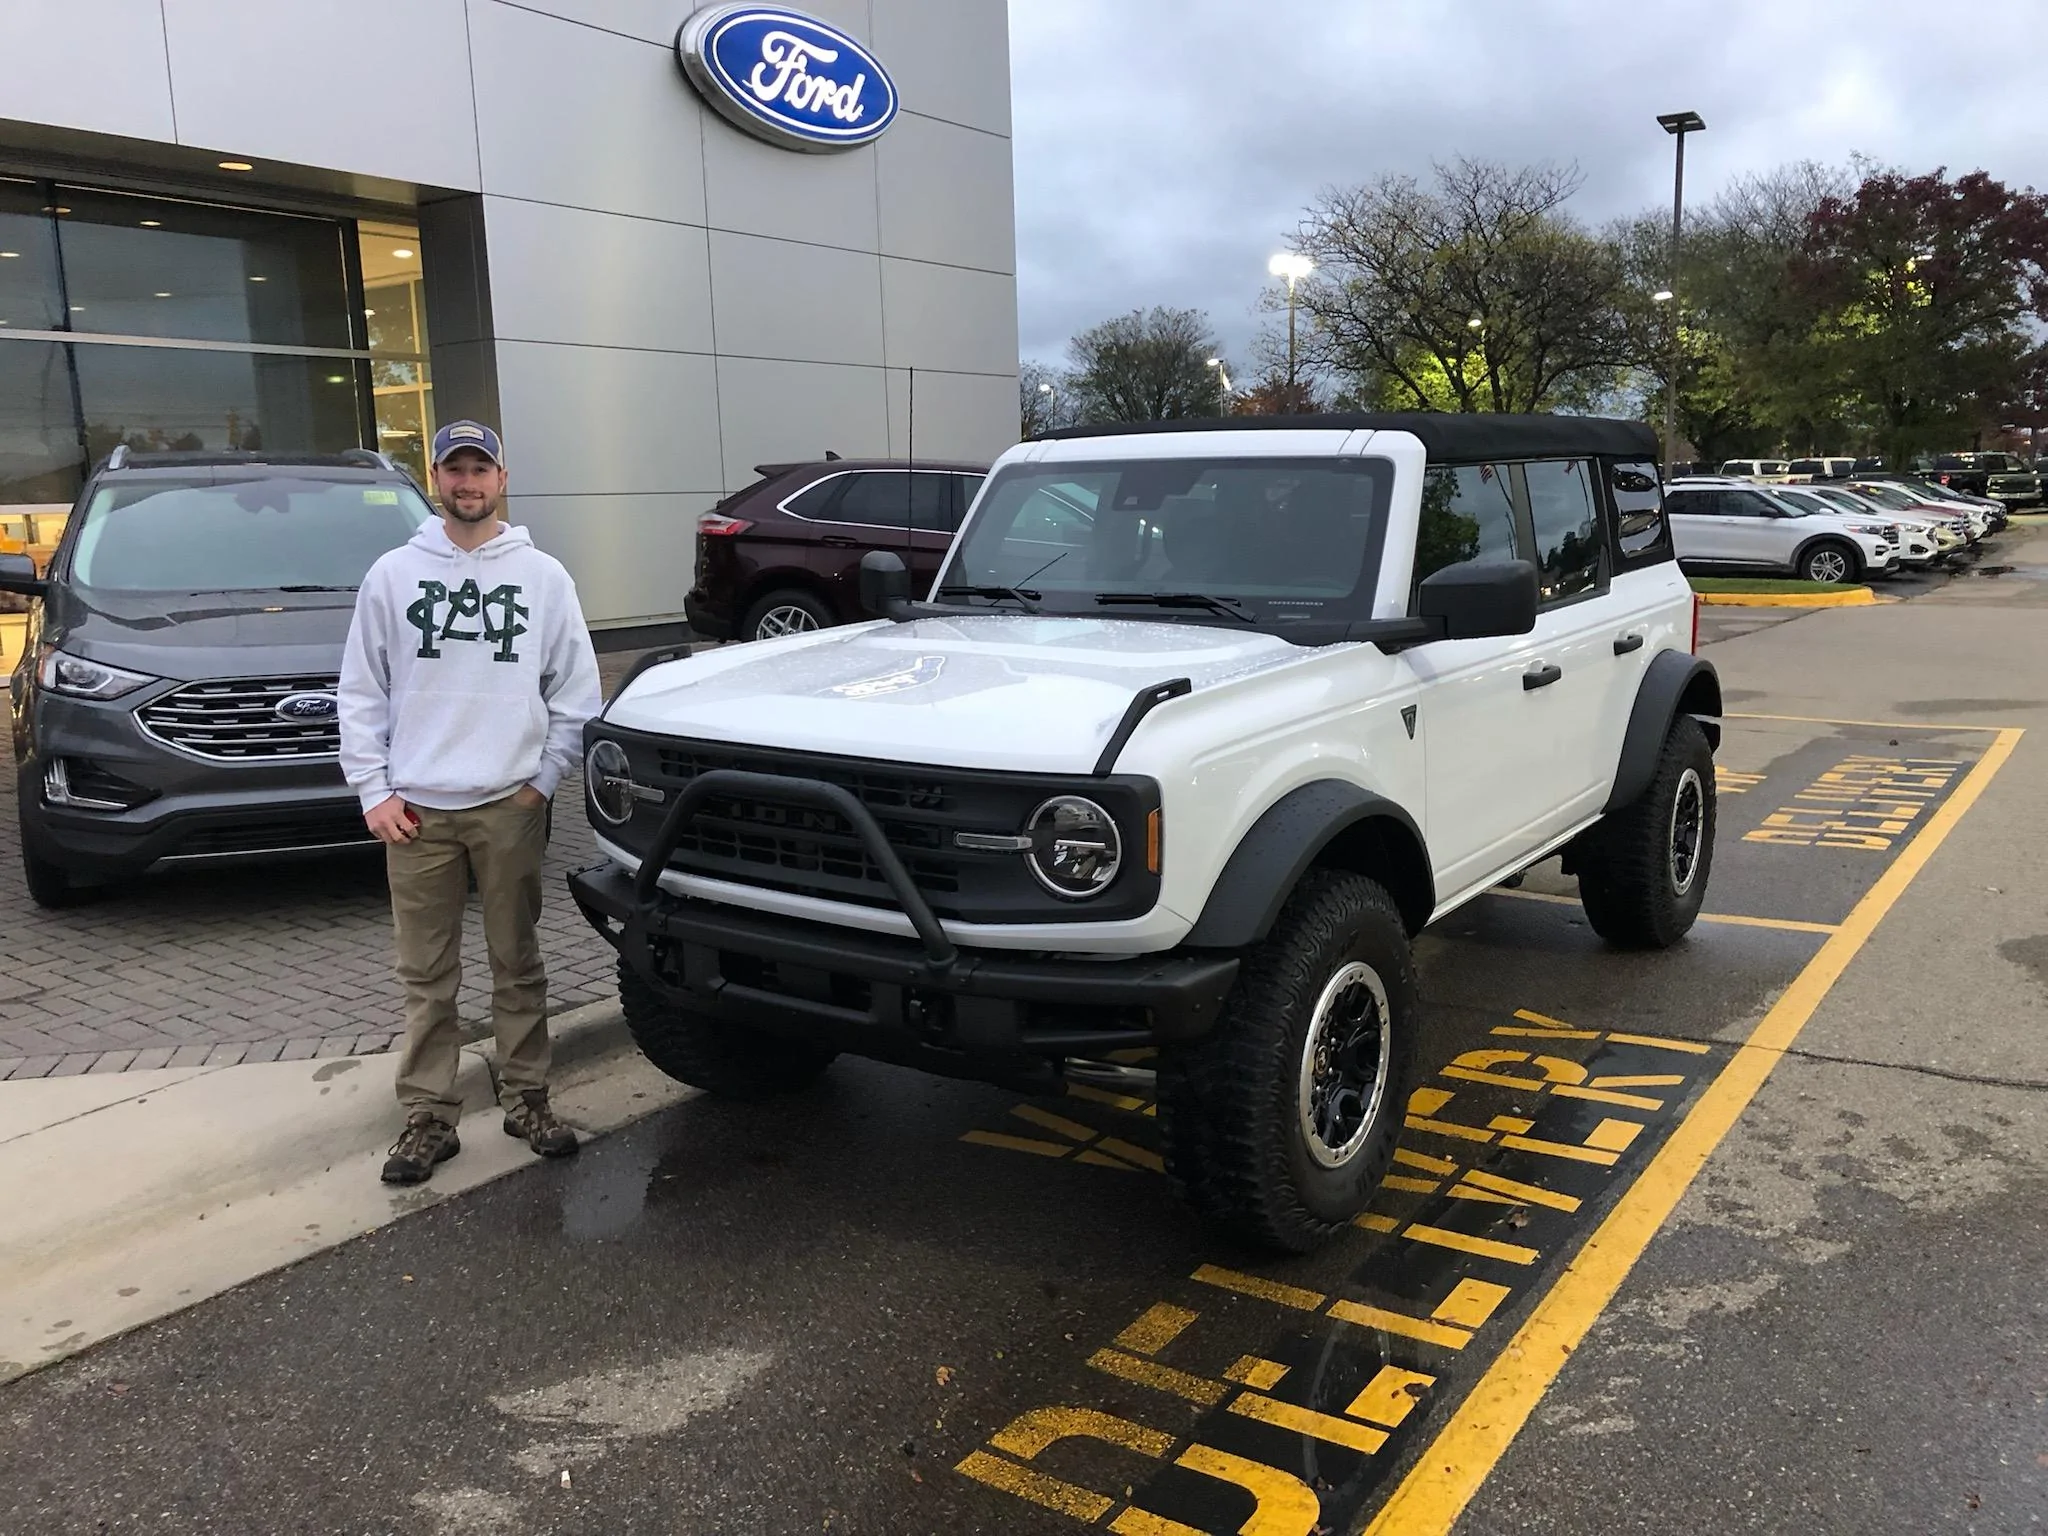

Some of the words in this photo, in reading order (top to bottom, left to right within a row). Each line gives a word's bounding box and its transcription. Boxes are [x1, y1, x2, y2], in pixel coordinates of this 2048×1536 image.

[742, 31, 866, 122] Ford
[293, 699, 330, 715] Ford
[1741, 755, 1963, 851] DELIVERY
[953, 1008, 1711, 1536] DELIVERY
